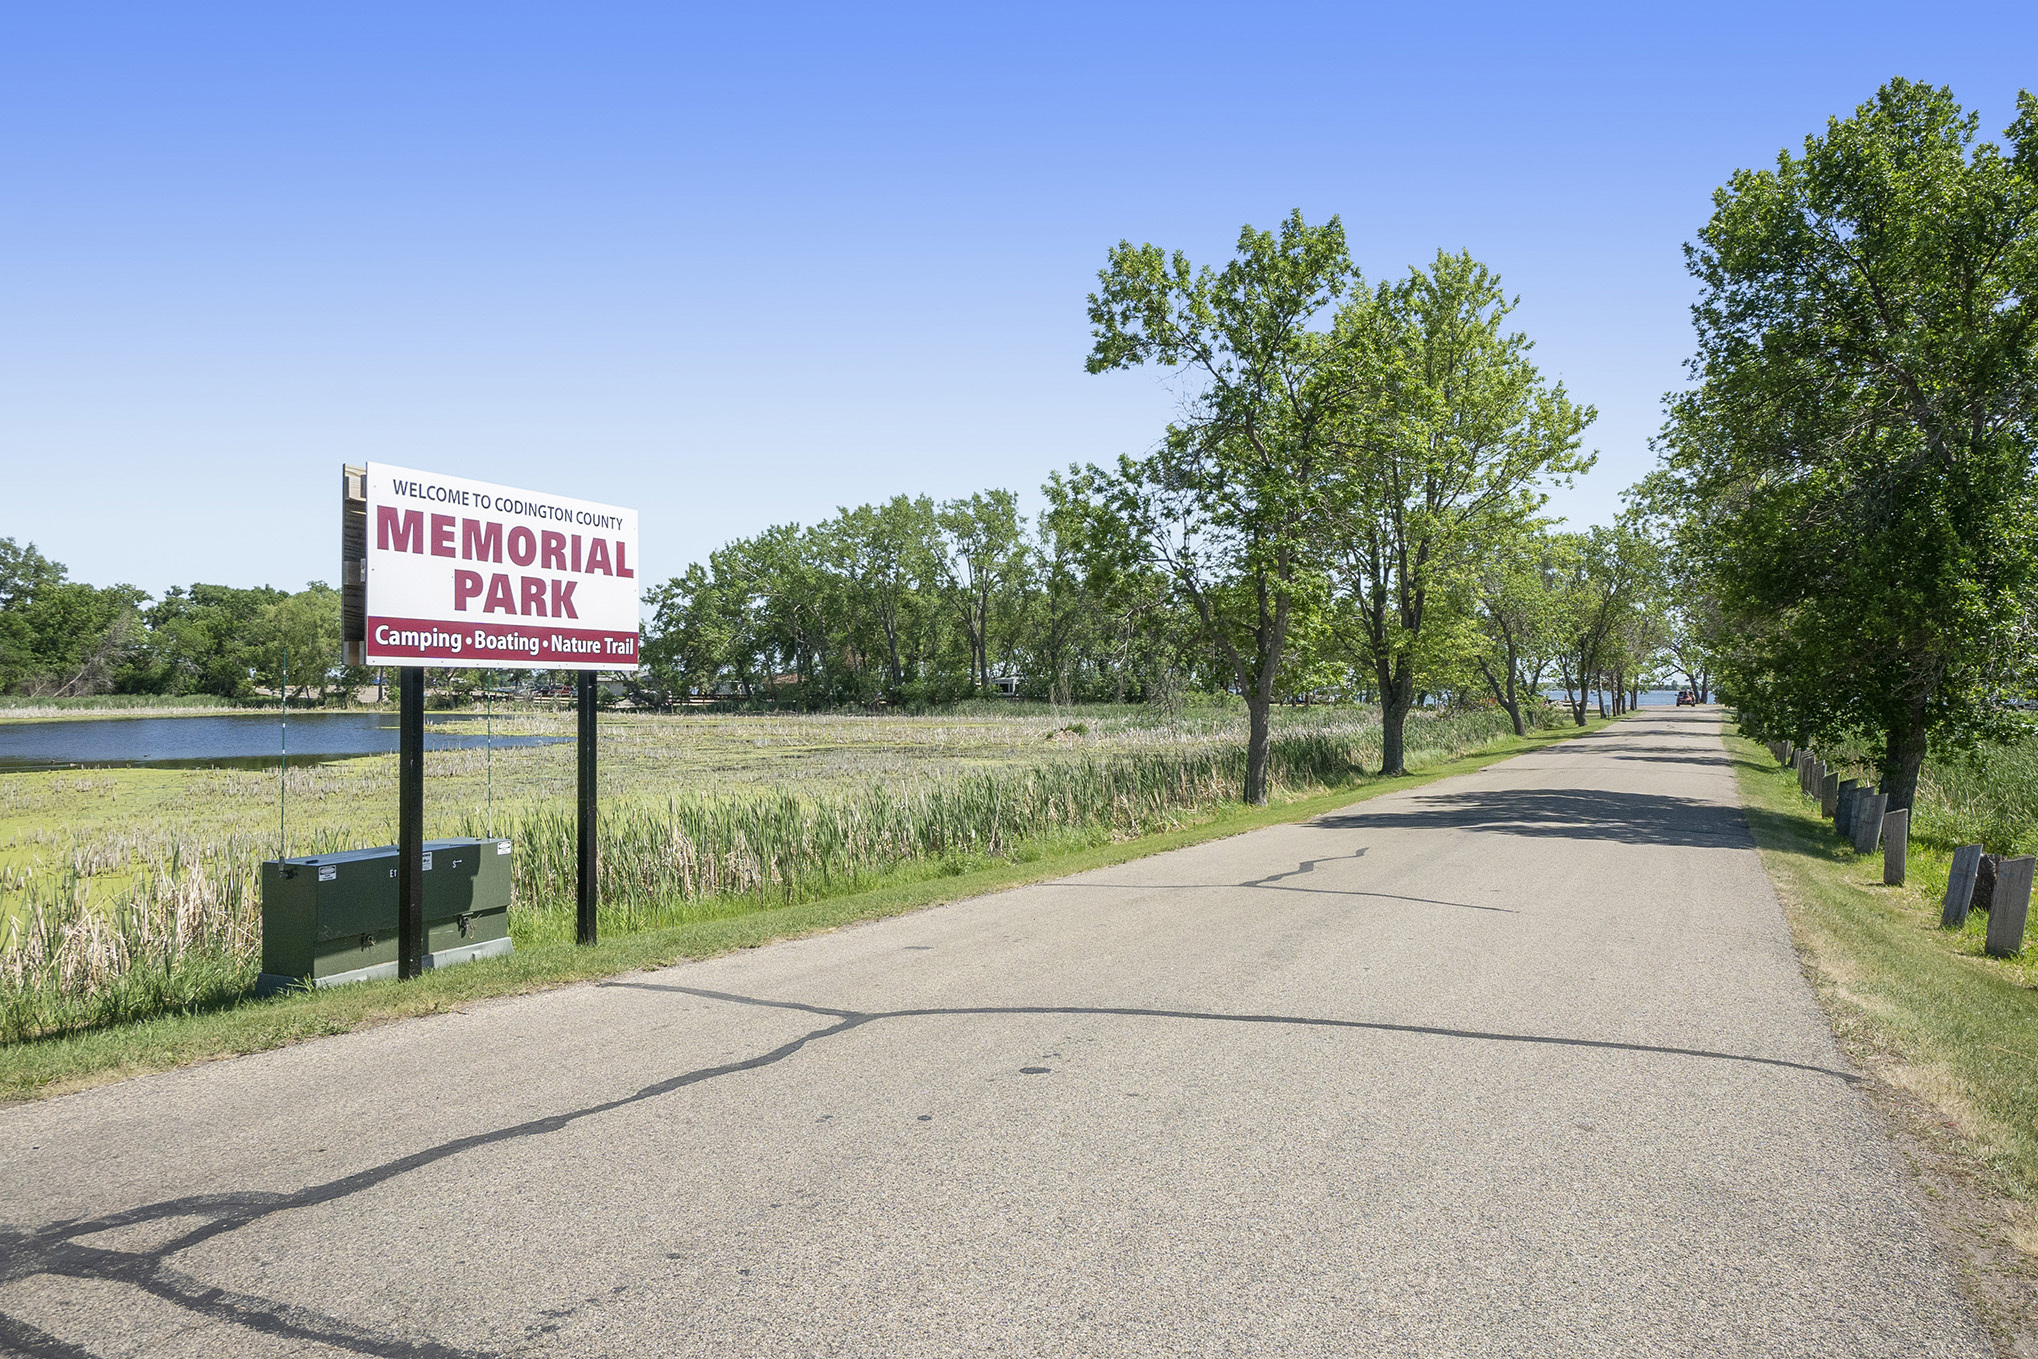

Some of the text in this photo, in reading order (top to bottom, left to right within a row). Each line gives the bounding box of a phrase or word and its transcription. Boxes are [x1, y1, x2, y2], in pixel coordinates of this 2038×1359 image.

[393, 479, 623, 530] WELCOME TO CODINGTON COUNTY
[376, 505, 634, 579] MEMORIAL
[454, 569, 579, 620] PARK
[375, 625, 634, 656] Camping Boating Nature Trail
